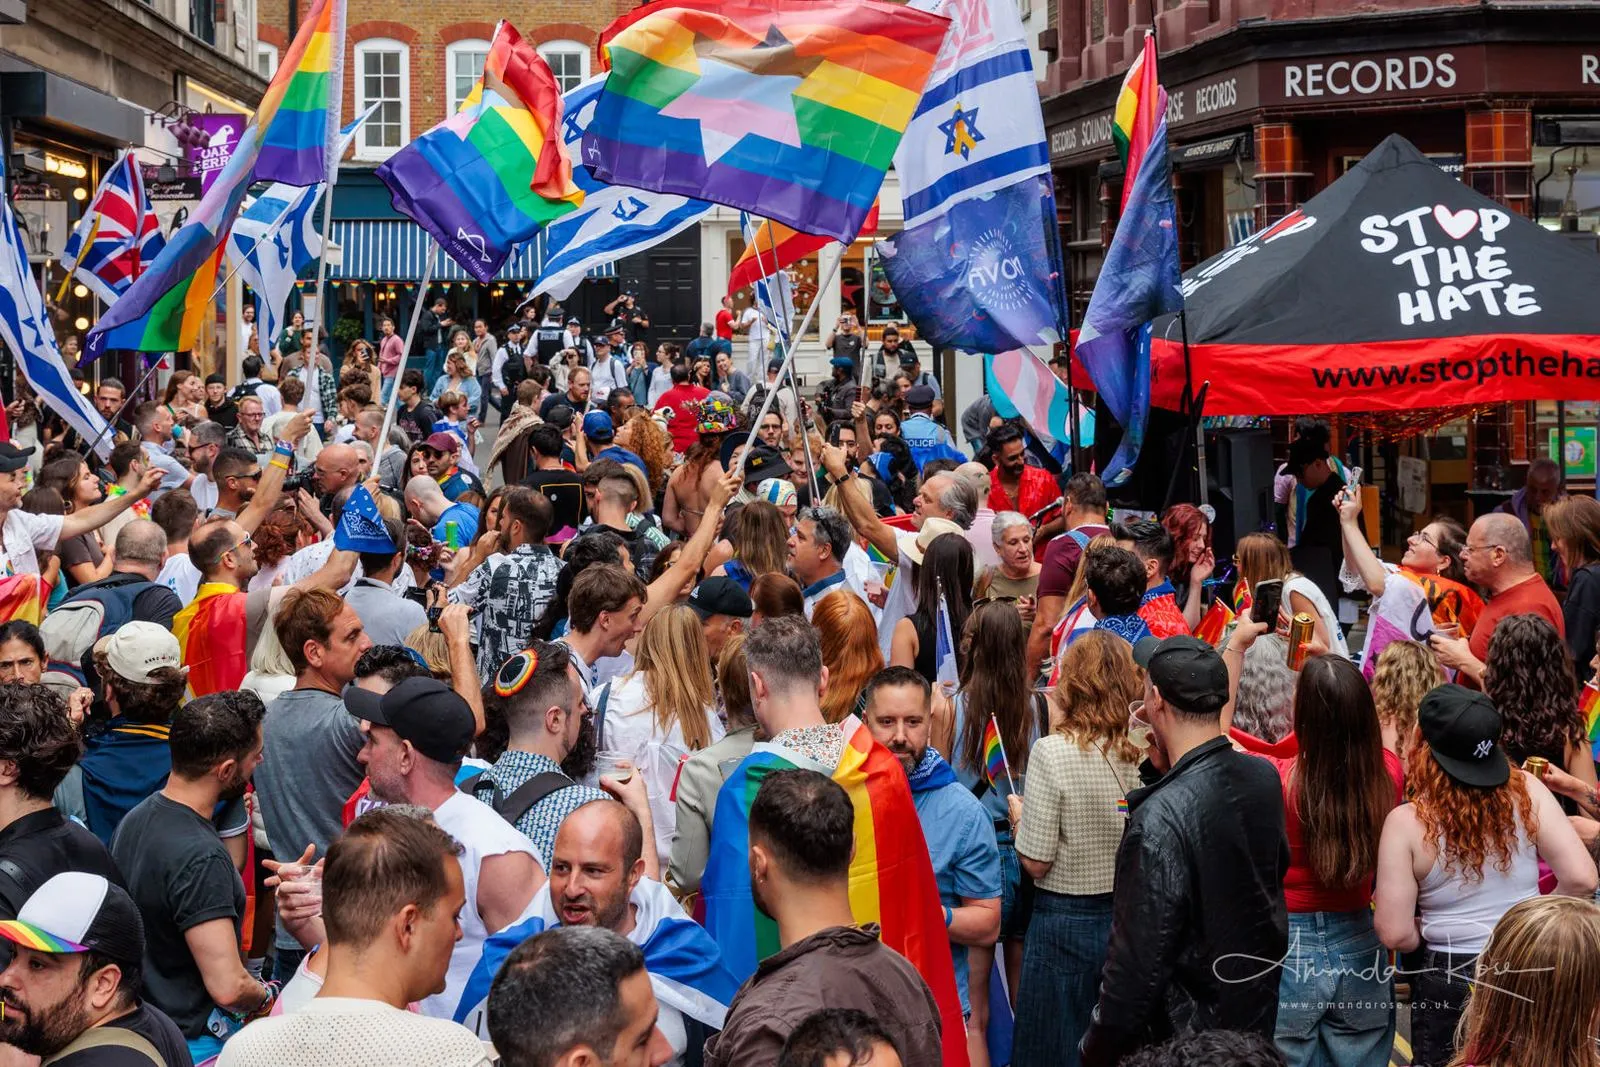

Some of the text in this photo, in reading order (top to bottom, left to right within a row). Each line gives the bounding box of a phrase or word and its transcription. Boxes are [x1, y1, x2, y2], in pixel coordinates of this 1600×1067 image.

[1285, 53, 1457, 97] RECORDS
[1051, 77, 1237, 153] RECORDS SOUNDS RSE RECORDS
[201, 144, 229, 159] OAK
[1392, 245, 1513, 287] THE
[1398, 281, 1542, 325] HATE
